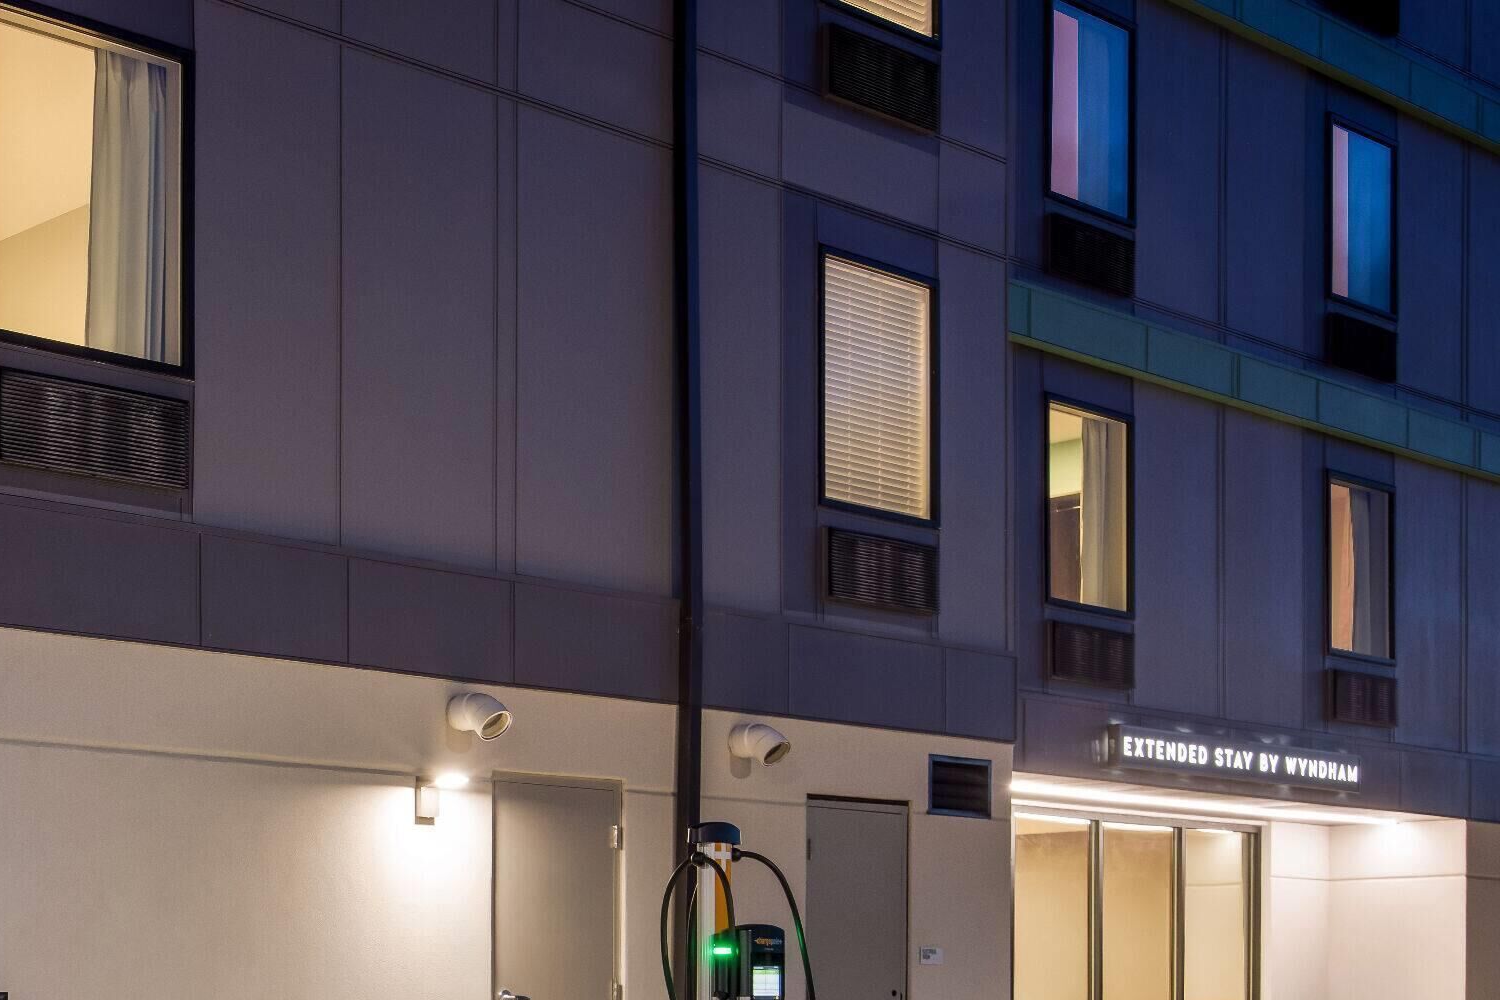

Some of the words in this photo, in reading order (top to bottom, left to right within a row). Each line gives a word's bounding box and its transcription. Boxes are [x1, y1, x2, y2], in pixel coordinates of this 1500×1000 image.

[1123, 736, 1208, 765] EXTENDED
[1215, 748, 1253, 770] STAY
[1260, 754, 1279, 774] BY
[1285, 756, 1358, 783] WYNDHAM
